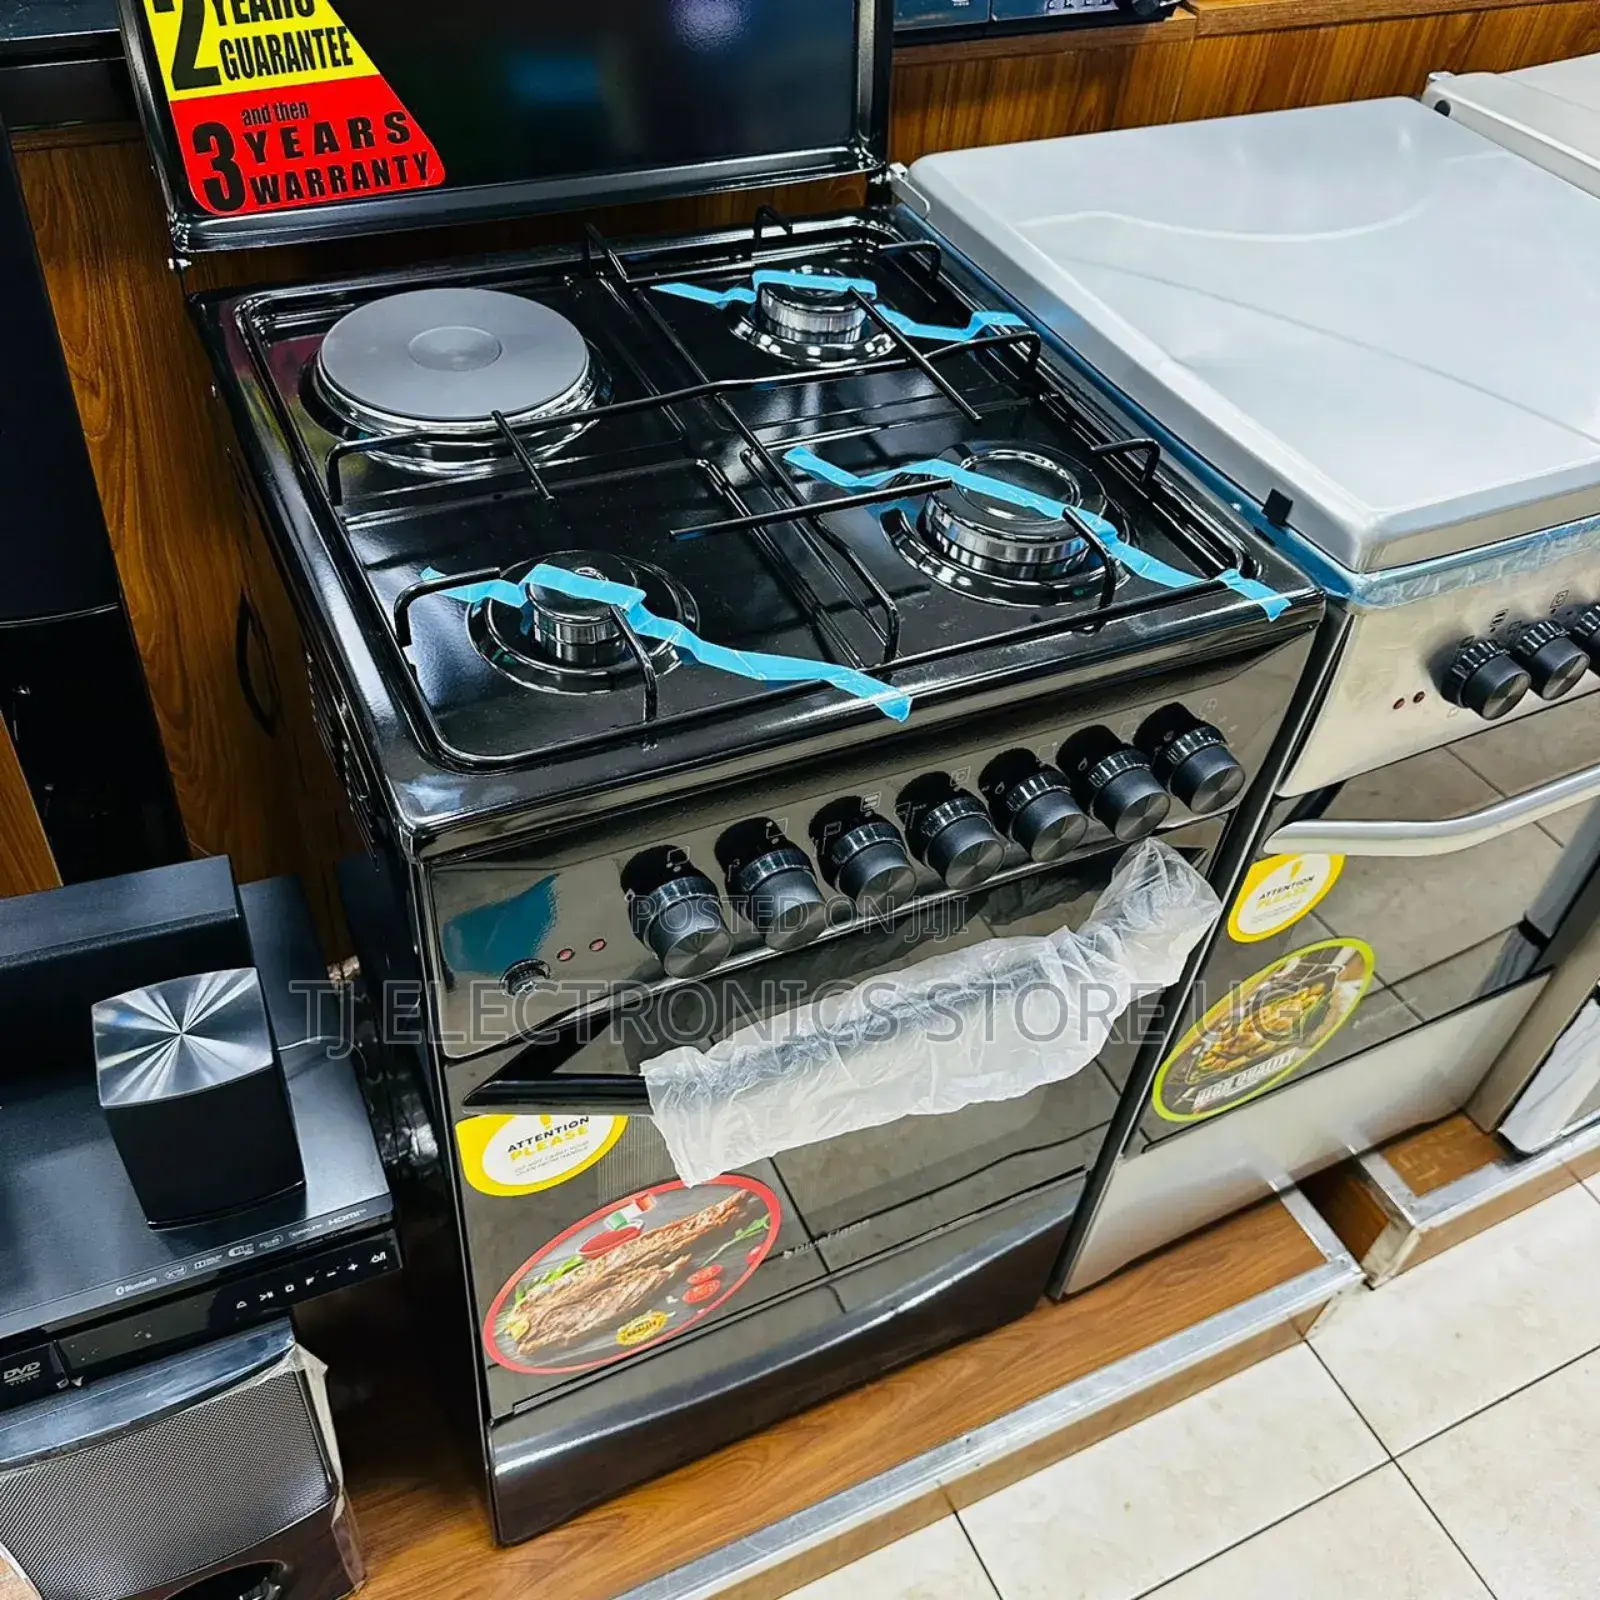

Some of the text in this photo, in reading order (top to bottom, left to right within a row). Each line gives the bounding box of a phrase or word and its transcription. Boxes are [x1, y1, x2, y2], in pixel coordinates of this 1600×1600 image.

[153, 0, 222, 91] 2
[219, 26, 354, 81] GUARANTEE
[241, 101, 310, 126] and then
[192, 110, 411, 212] 3 YEARS
[250, 151, 428, 206] WARRANTY
[508, 1116, 589, 1152] ATTENTION
[510, 1126, 588, 1161] PLEASE
[4, 1361, 41, 1380] DVD
